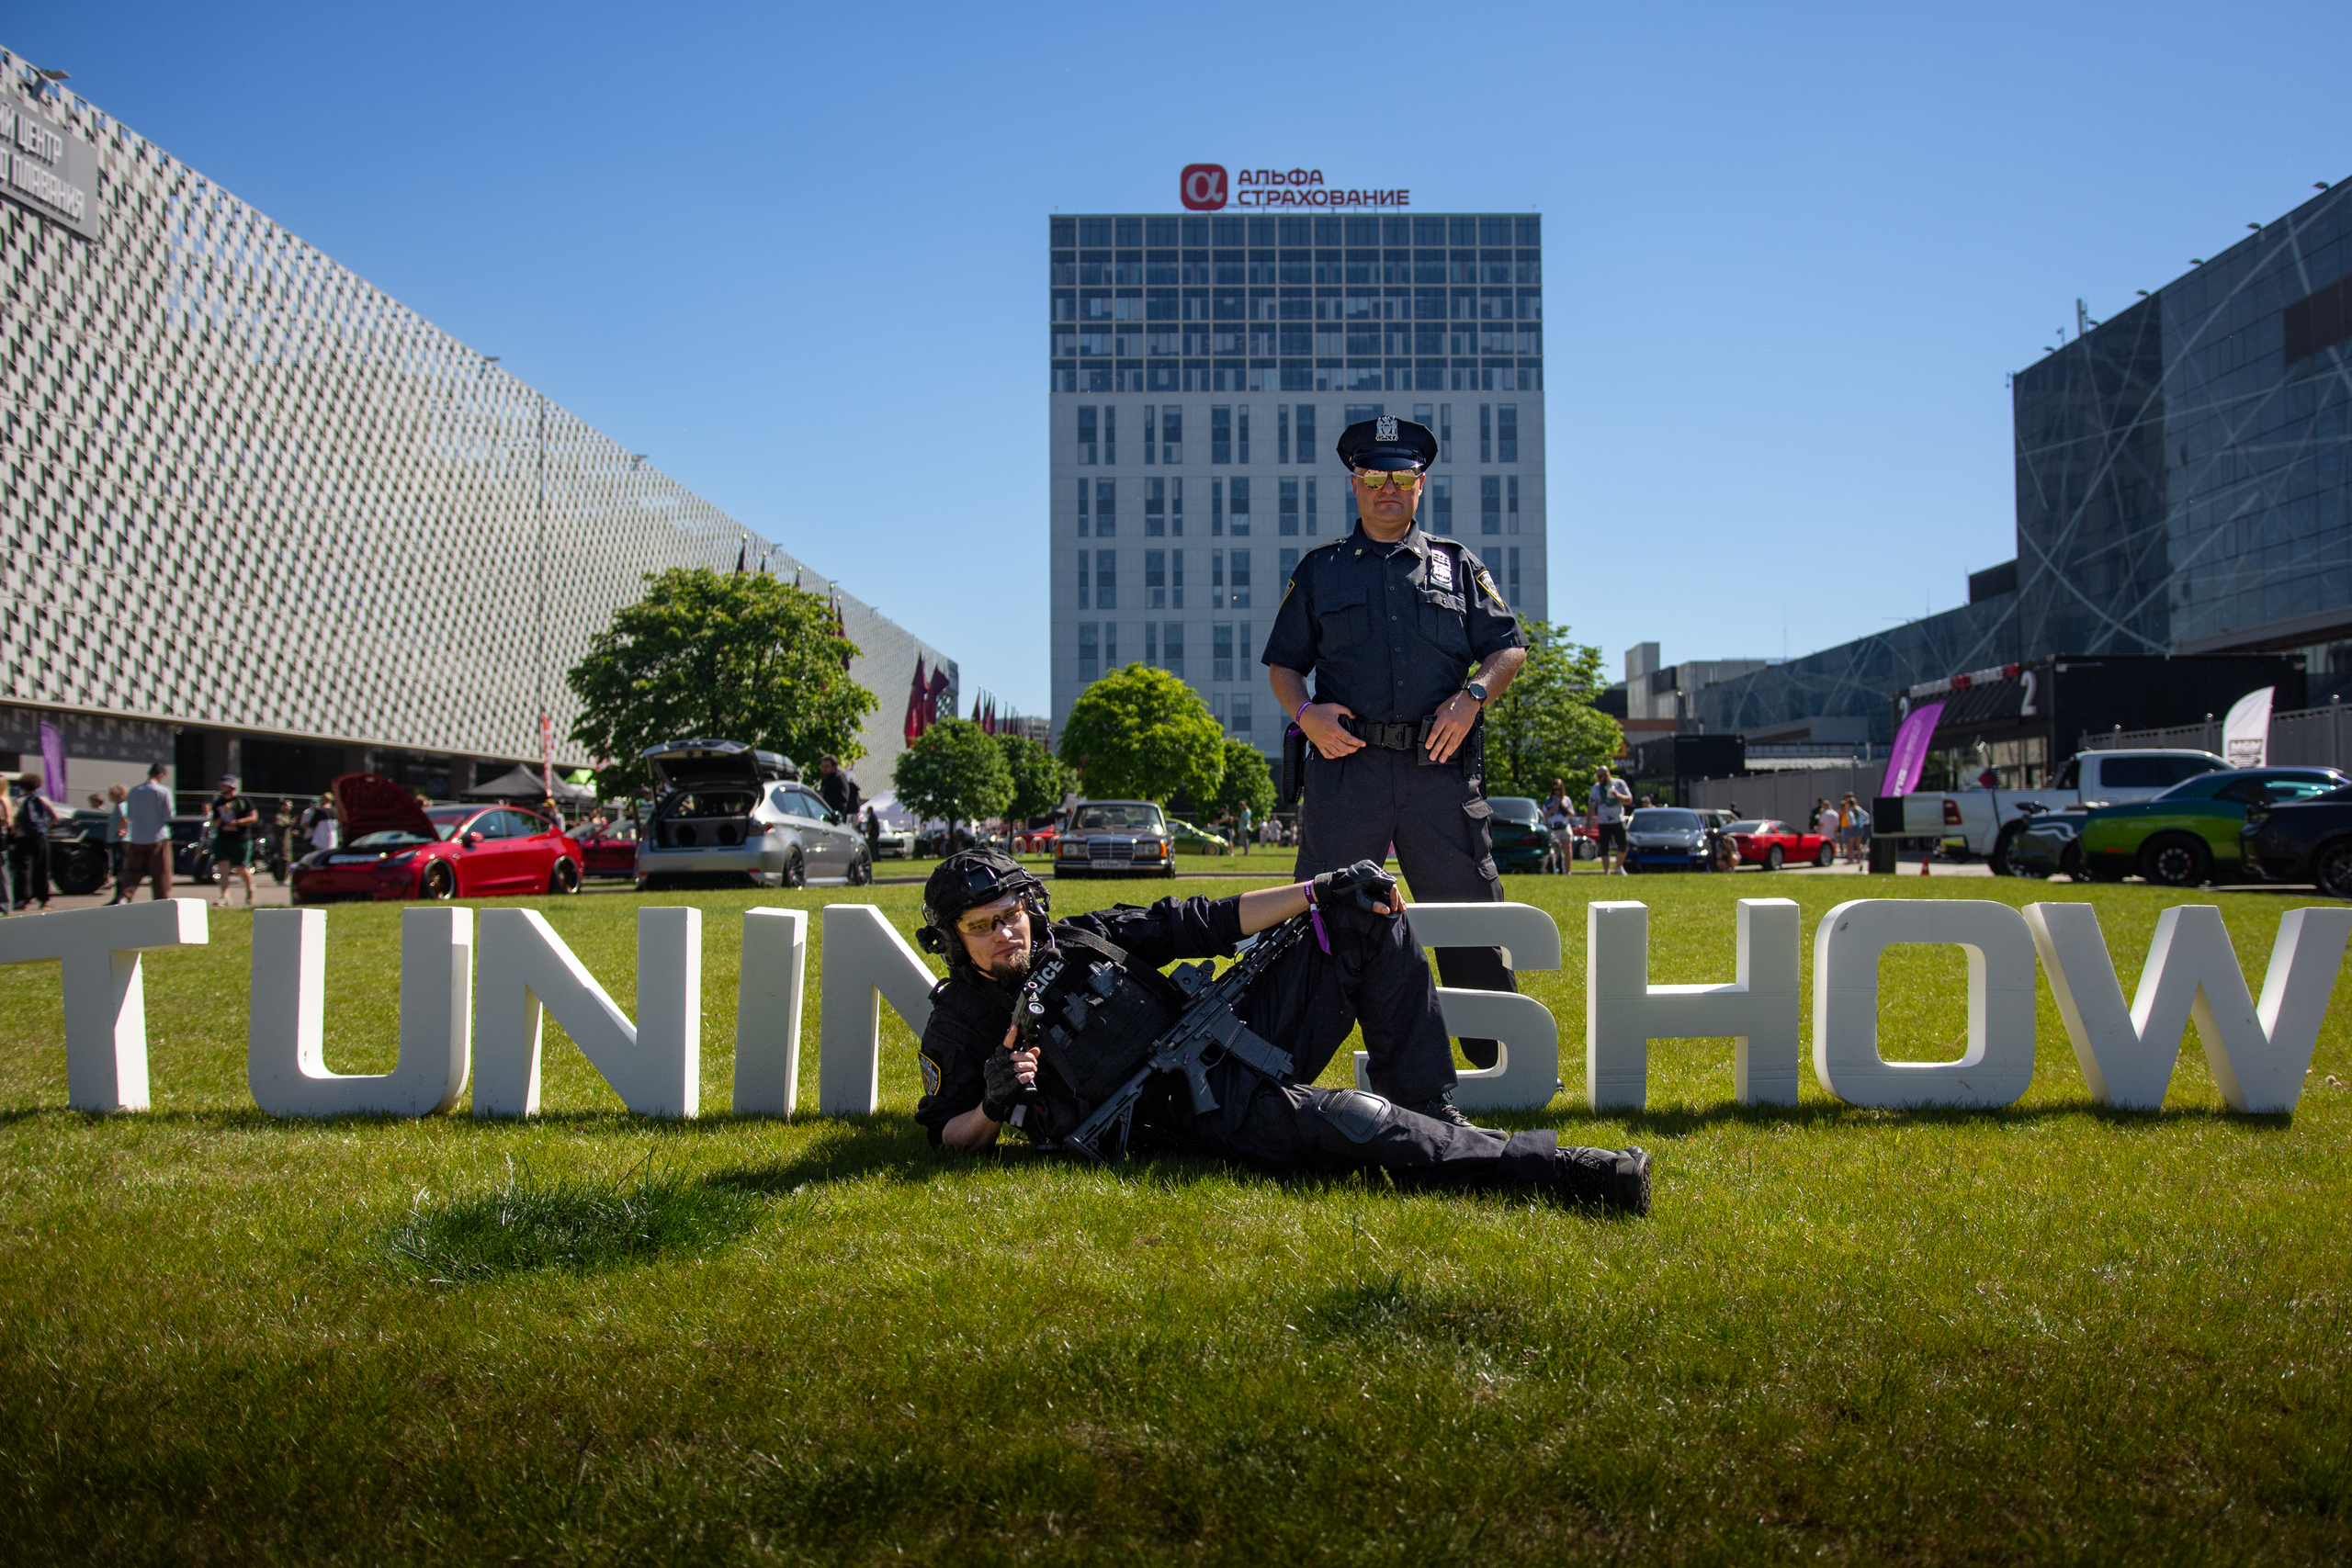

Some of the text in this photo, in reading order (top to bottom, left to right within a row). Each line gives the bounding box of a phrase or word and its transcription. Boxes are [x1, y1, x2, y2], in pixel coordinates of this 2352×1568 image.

[18, 113, 62, 164] ЦЕНТР
[12, 153, 85, 221] ПЛАВАНИЯ
[1238, 168, 1324, 186] АЛЬФА
[1238, 189, 1411, 206] СТРАХОВАНИЕ
[2020, 671, 2038, 716] 2
[1034, 960, 1065, 994] LICE
[0, 897, 2352, 1118] TUNIN SHOW
